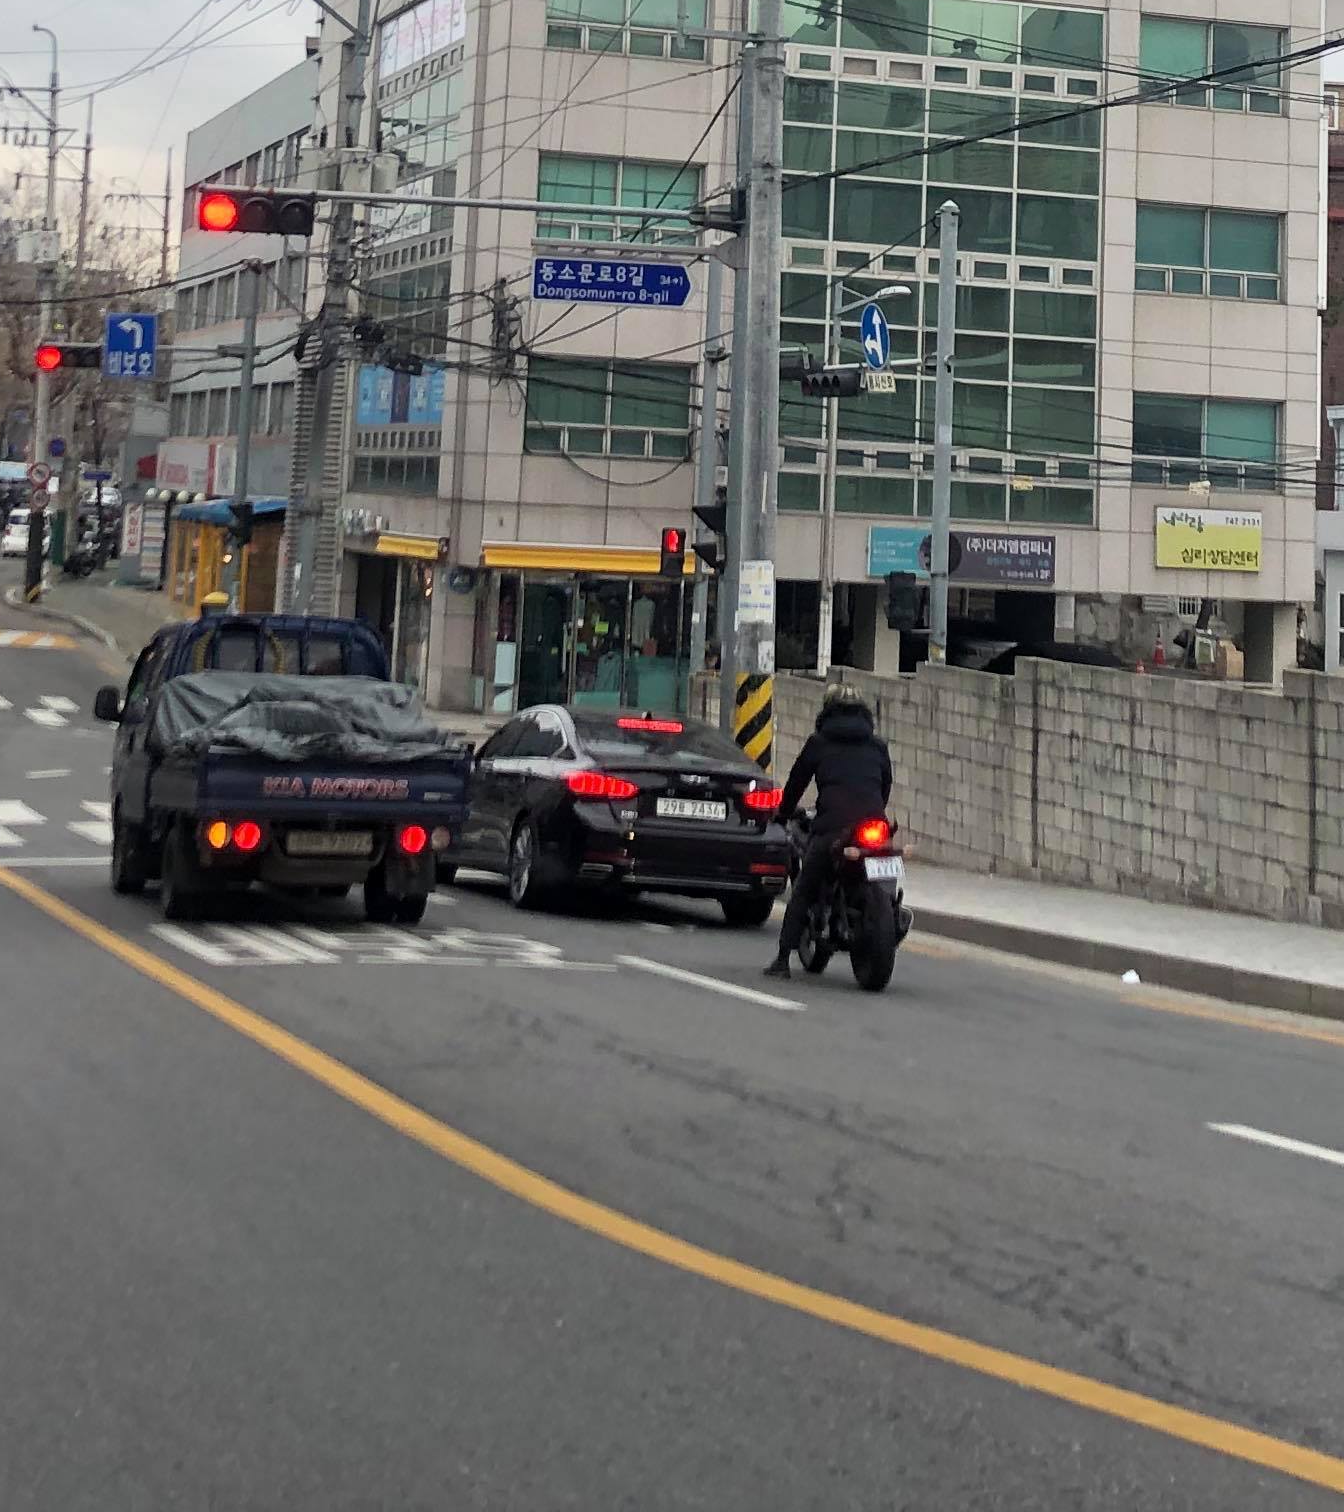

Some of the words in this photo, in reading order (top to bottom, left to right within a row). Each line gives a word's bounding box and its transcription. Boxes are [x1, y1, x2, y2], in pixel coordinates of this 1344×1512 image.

[539, 261, 644, 287] 동소문로8길
[537, 284, 636, 302] Dongsomun-ro
[638, 289, 669, 304] 8-gil
[109, 351, 153, 375] 비보호
[1181, 547, 1258, 567] 심리상담센터
[263, 776, 304, 797] KIA
[311, 777, 409, 800] MOTORS
